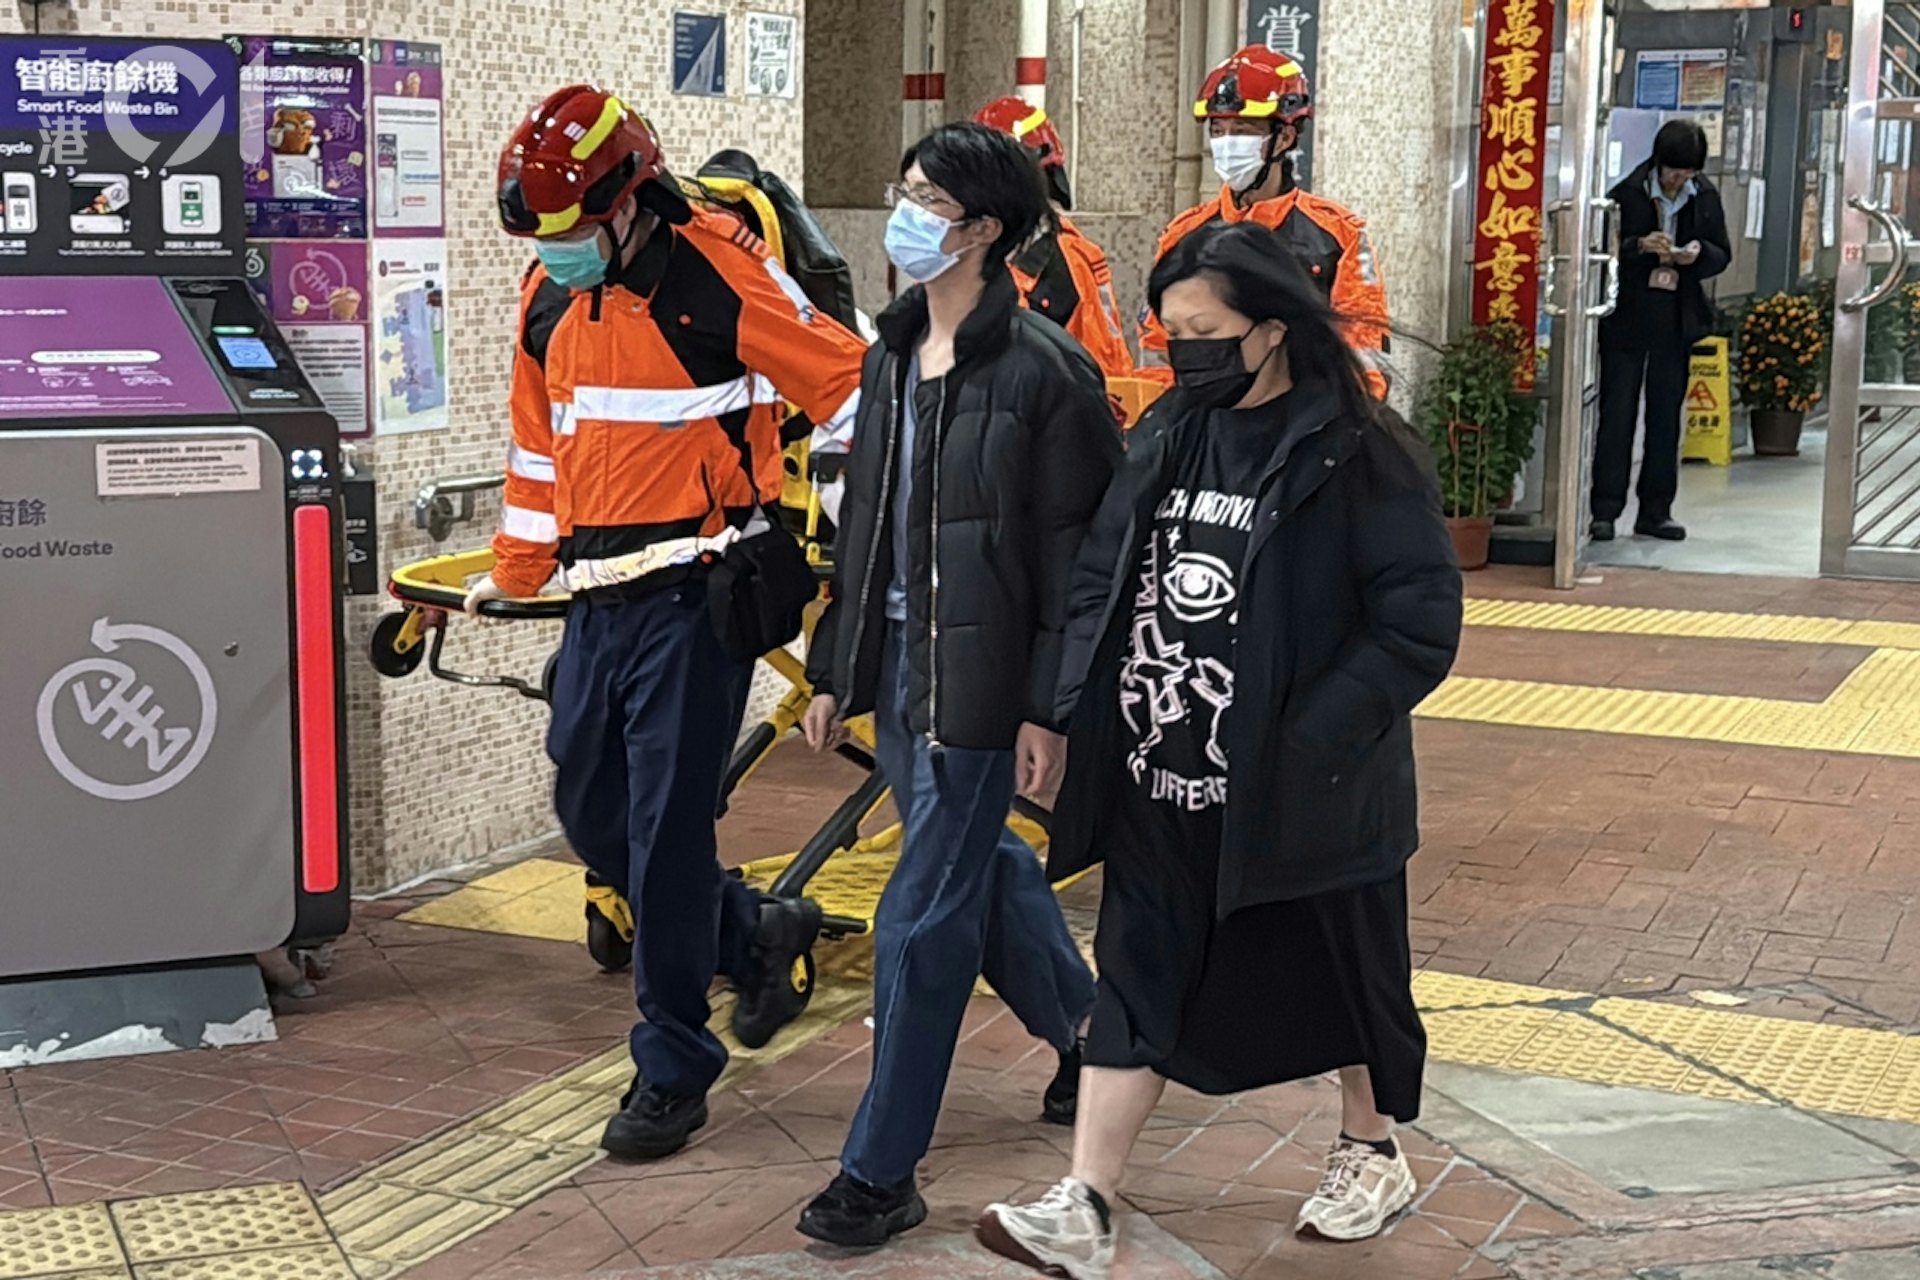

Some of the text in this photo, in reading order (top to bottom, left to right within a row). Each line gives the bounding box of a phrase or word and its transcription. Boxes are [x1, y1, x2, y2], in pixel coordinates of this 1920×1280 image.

[15, 57, 179, 94] 智能廚餘機
[17, 99, 179, 115] Smart Food Waste Bin
[66, 167, 75, 177] 3
[158, 167, 168, 177] 4
[0, 540, 113, 558] ood Waste
